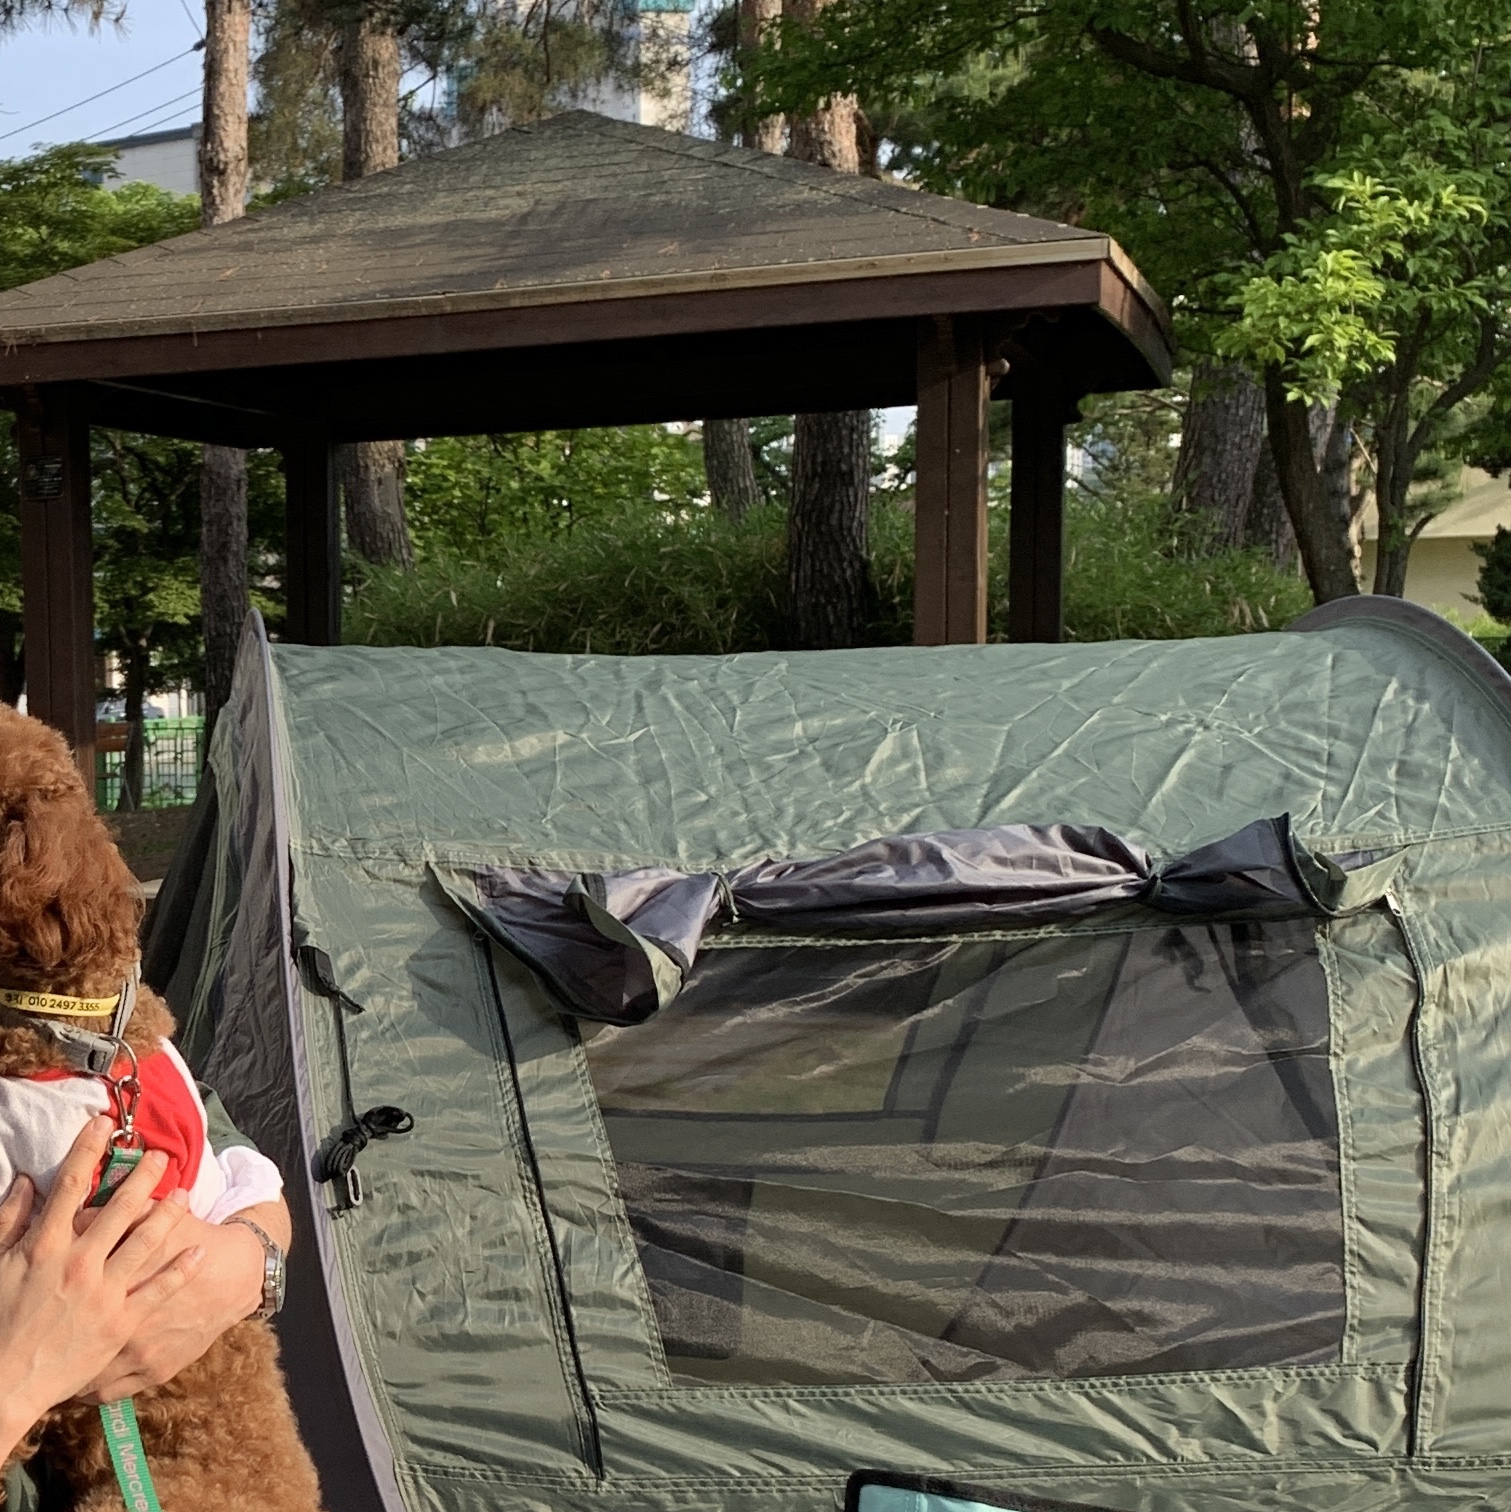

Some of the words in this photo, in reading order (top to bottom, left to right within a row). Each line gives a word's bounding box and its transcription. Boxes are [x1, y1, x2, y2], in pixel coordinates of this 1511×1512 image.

[28, 996, 47, 1008] 010
[49, 998, 77, 1011] 2497
[107, 1399, 131, 1440] ardi
